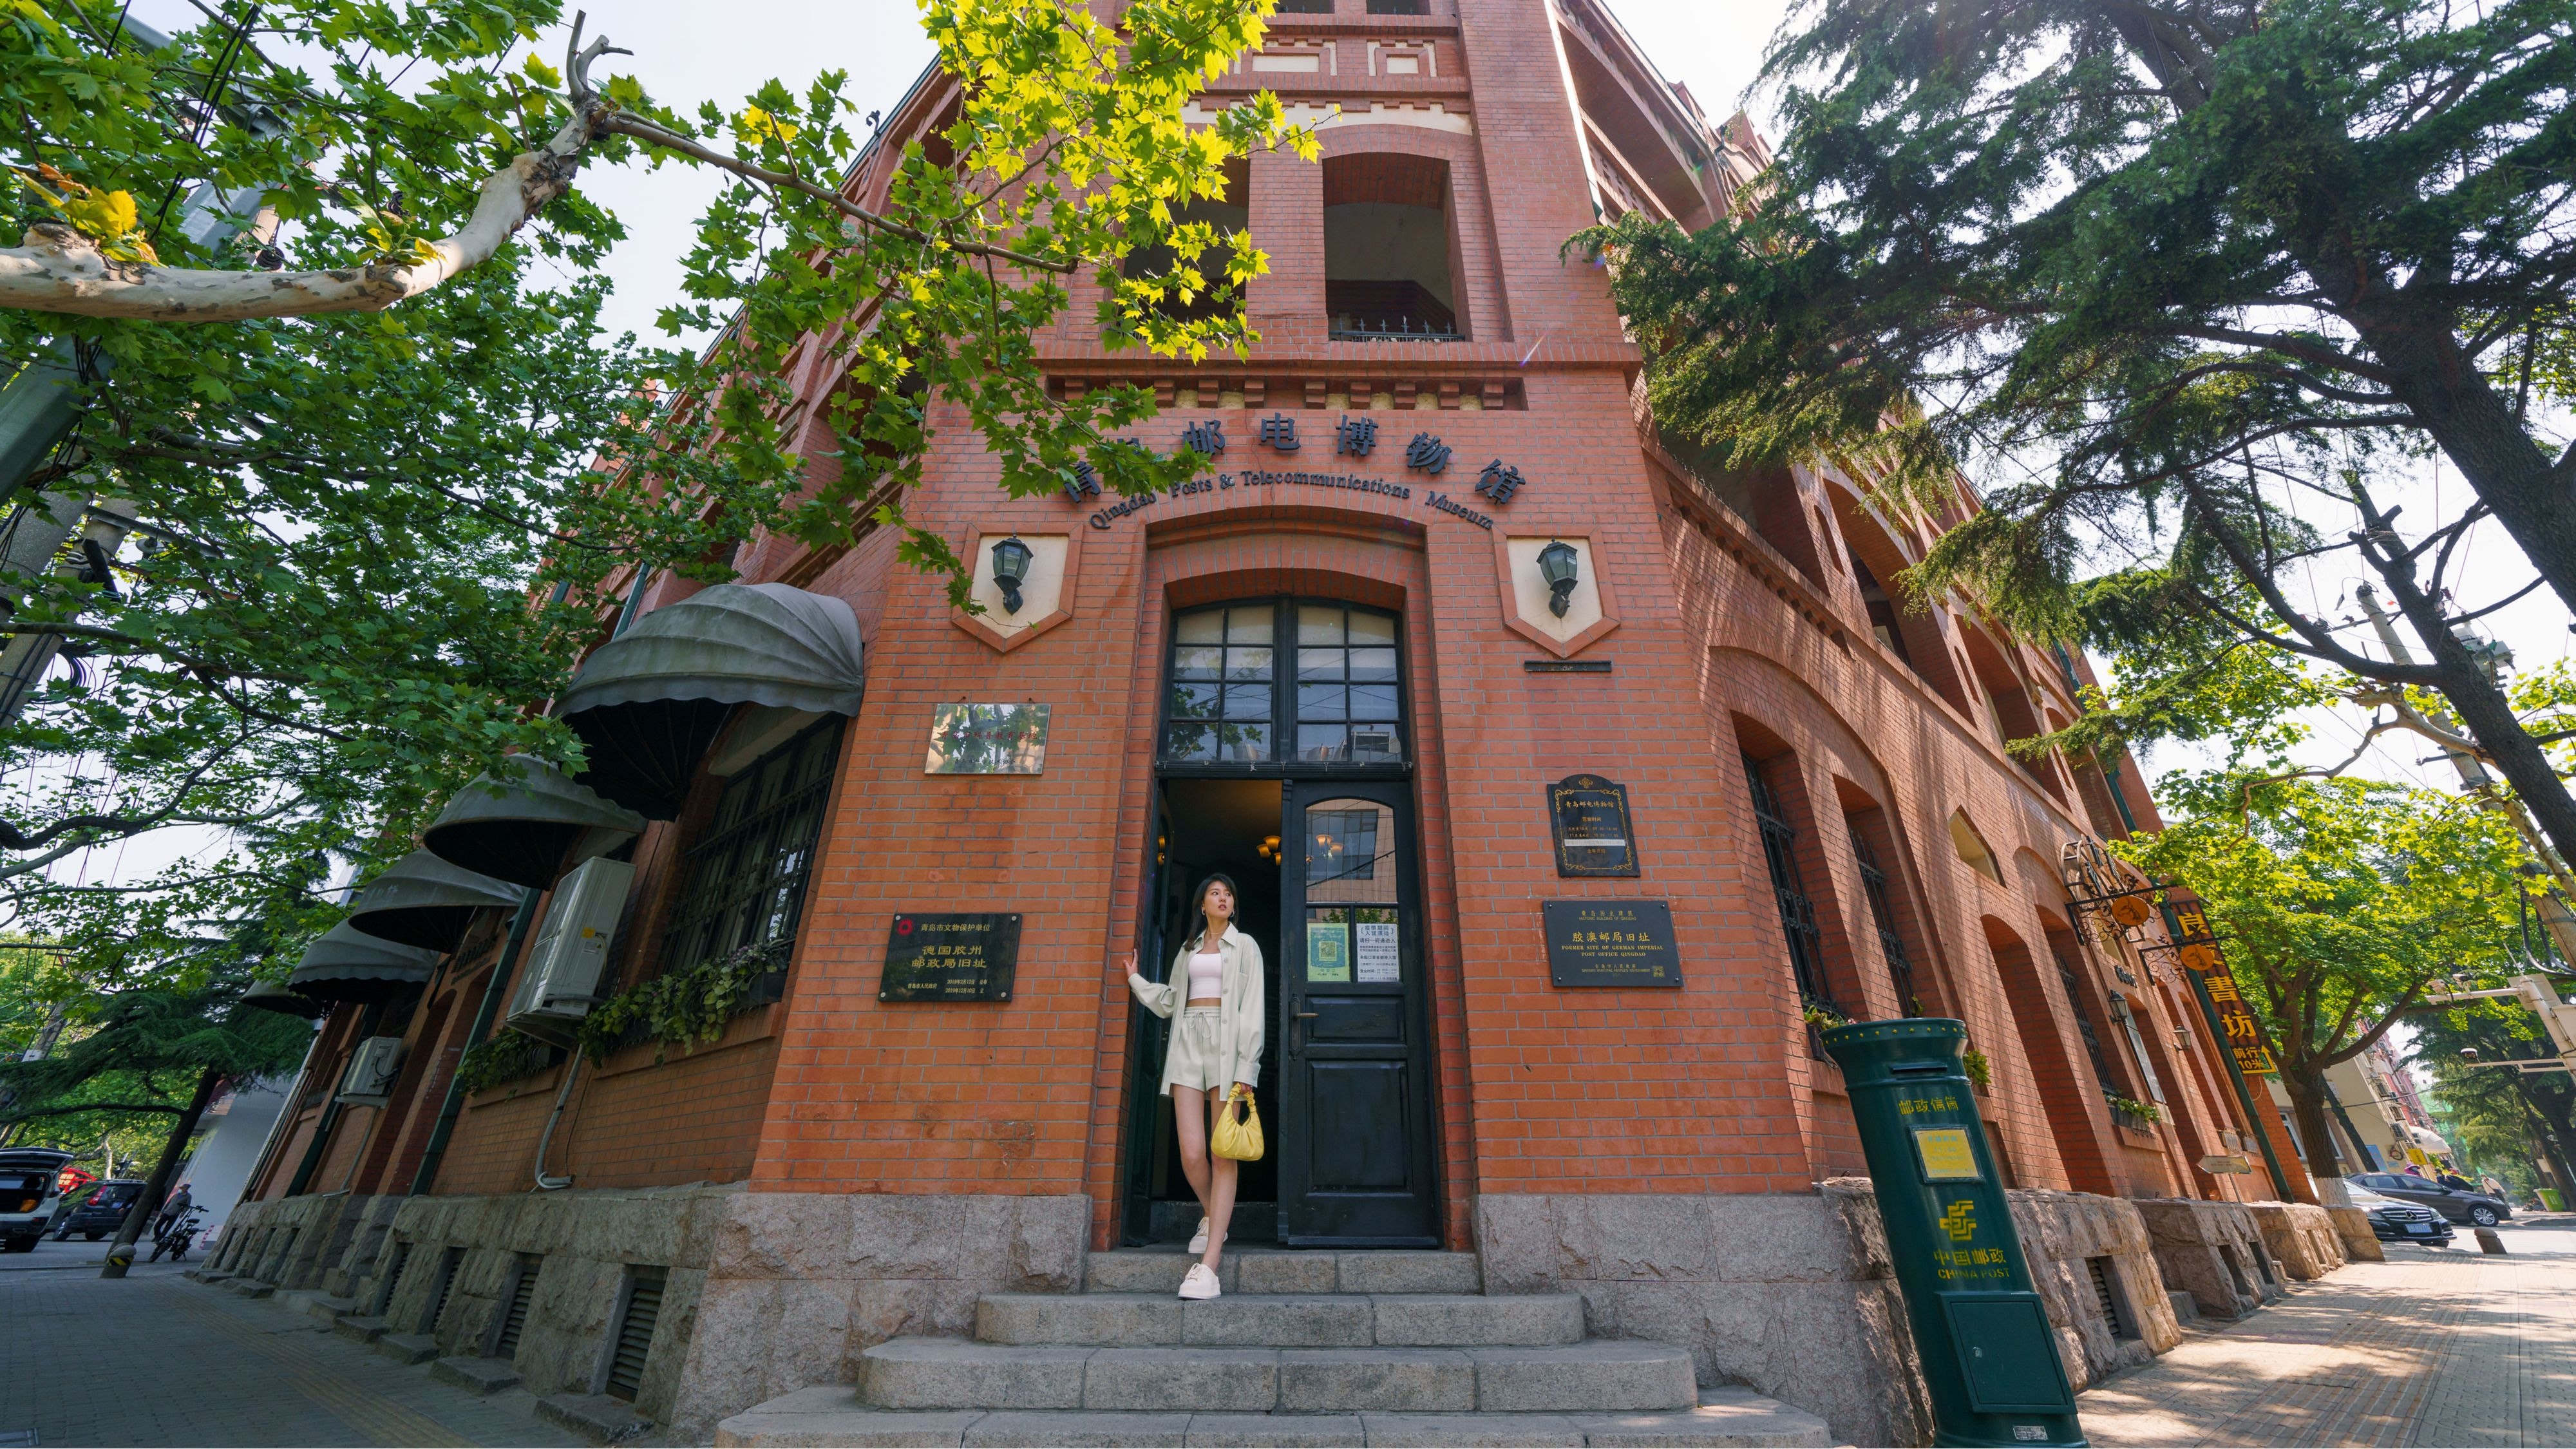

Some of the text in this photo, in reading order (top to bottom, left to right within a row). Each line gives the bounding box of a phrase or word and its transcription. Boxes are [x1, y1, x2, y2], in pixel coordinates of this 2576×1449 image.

[1063, 412, 1526, 505] 青邮电博物馆
[1169, 478, 1213, 498] Posts
[1219, 473, 1235, 489] &
[1240, 470, 1410, 500] Telecommunications
[1425, 491, 1494, 530] Museum
[921, 923, 990, 932] 青岛市文物保护单位
[1573, 931, 1651, 943] 胶澳邮局旧址
[922, 945, 982, 956] 德国胶州
[912, 958, 987, 969] 邮政局旧址
[2232, 1046, 2260, 1059] 前行
[2238, 1059, 2264, 1070] 10米
[1899, 1096, 1958, 1115] 邮政信筒
[1933, 1247, 2007, 1265] 中国邮政
[1938, 1267, 2010, 1280] CHINA POST
